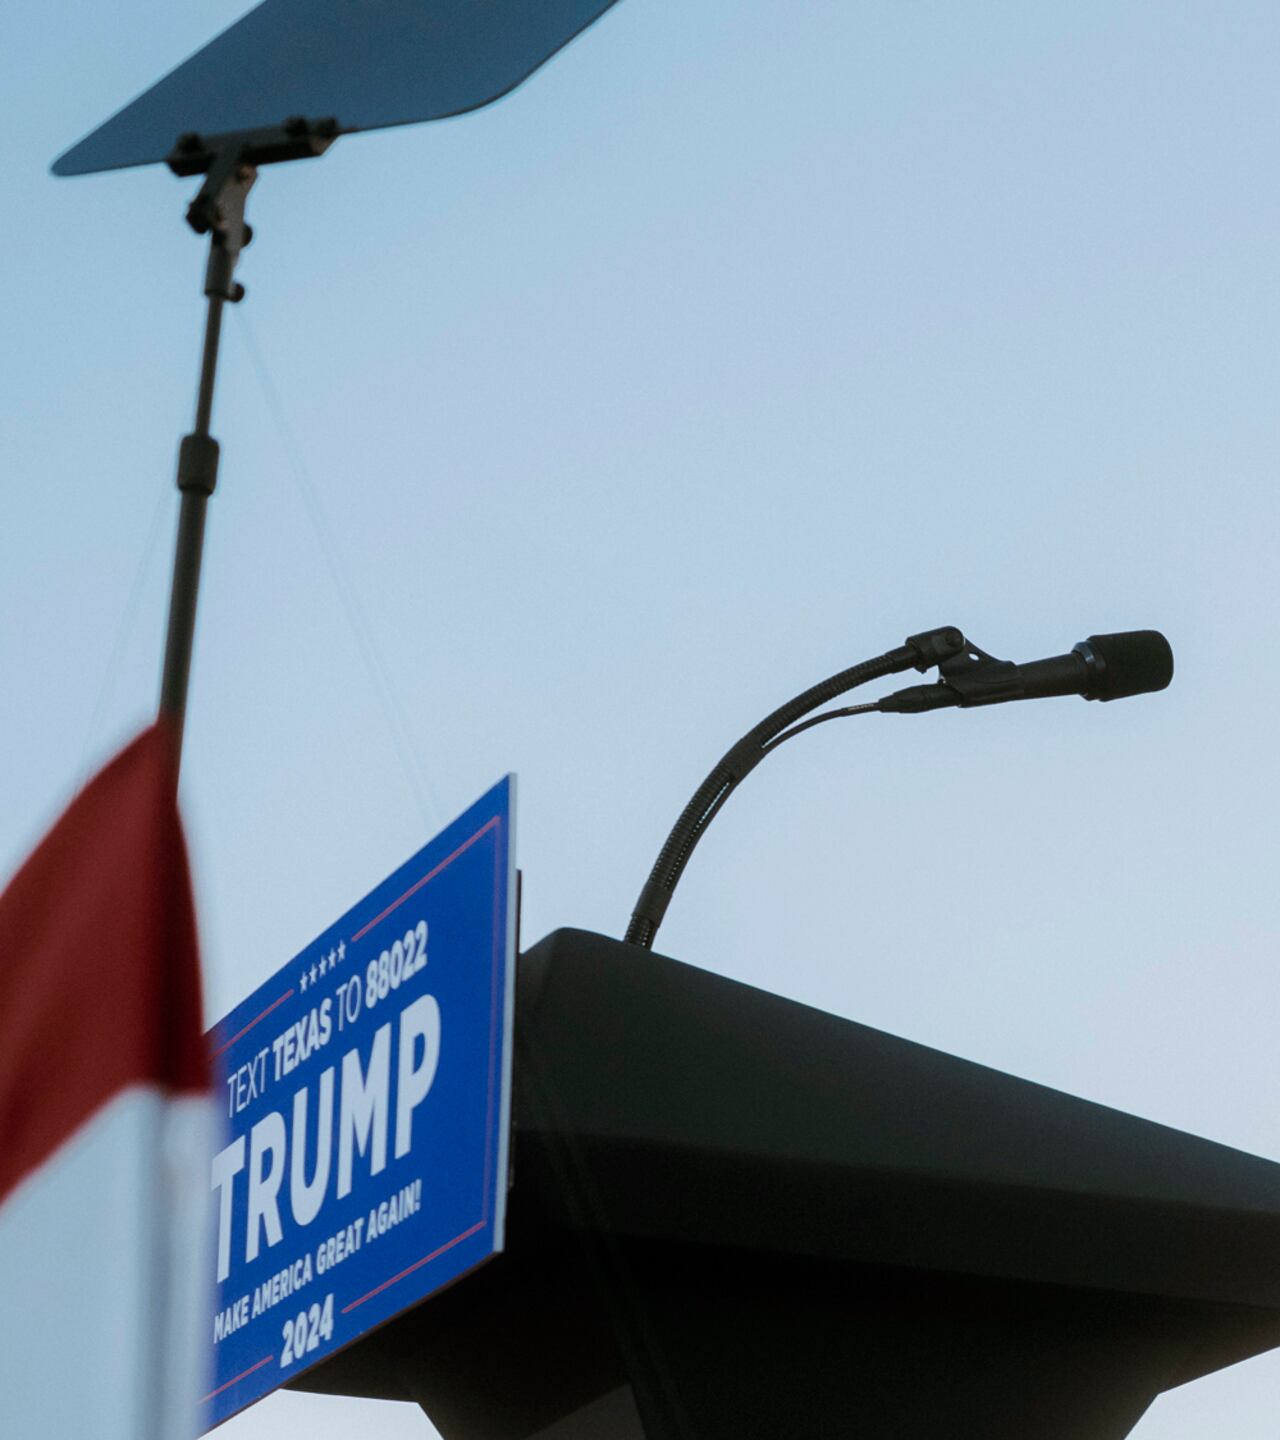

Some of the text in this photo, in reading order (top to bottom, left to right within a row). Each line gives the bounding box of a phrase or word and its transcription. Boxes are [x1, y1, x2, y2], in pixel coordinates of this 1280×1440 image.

[227, 919, 429, 1118] TEXT TEXAS TO 88022
[210, 994, 441, 1285] TRUMP
[213, 1178, 422, 1345] MAKE AMERICA GREAT AGAIN!
[280, 1293, 334, 1369] 2024
